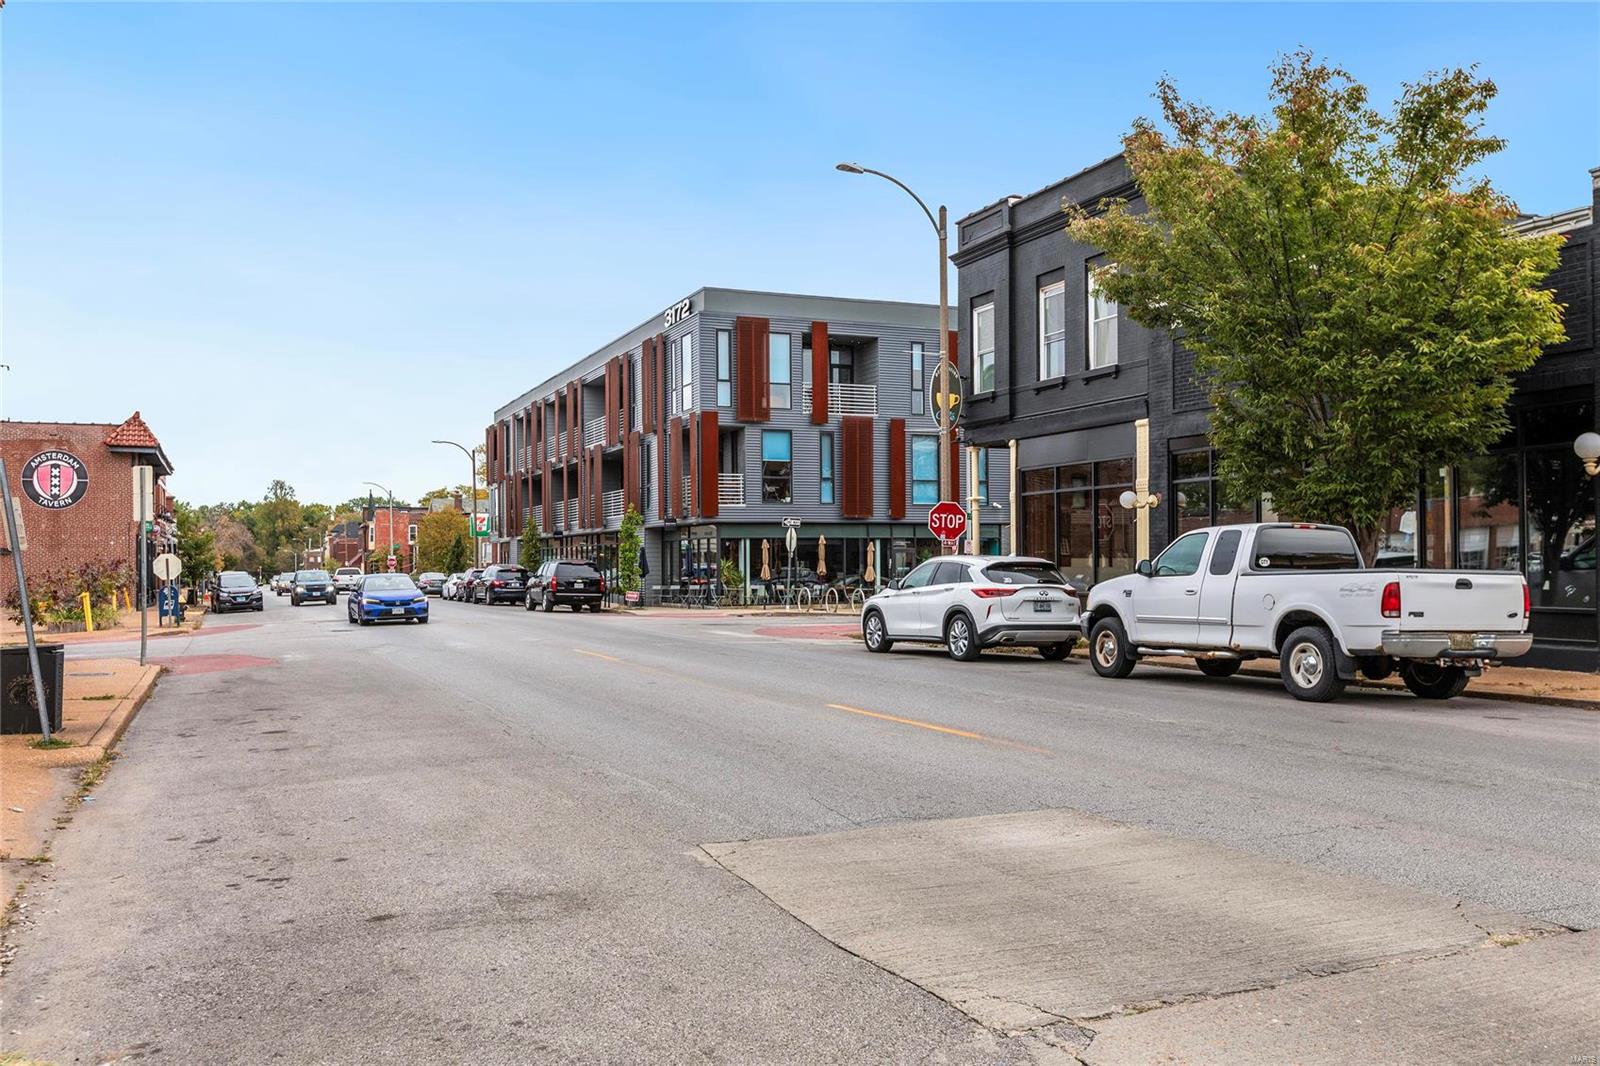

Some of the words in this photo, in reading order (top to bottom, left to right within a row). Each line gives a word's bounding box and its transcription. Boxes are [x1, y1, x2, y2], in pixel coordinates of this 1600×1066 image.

[664, 298, 690, 328] 3172
[30, 452, 80, 469] AMSTERDAM
[38, 497, 73, 507] TAVERN
[931, 513, 964, 529] STOP
